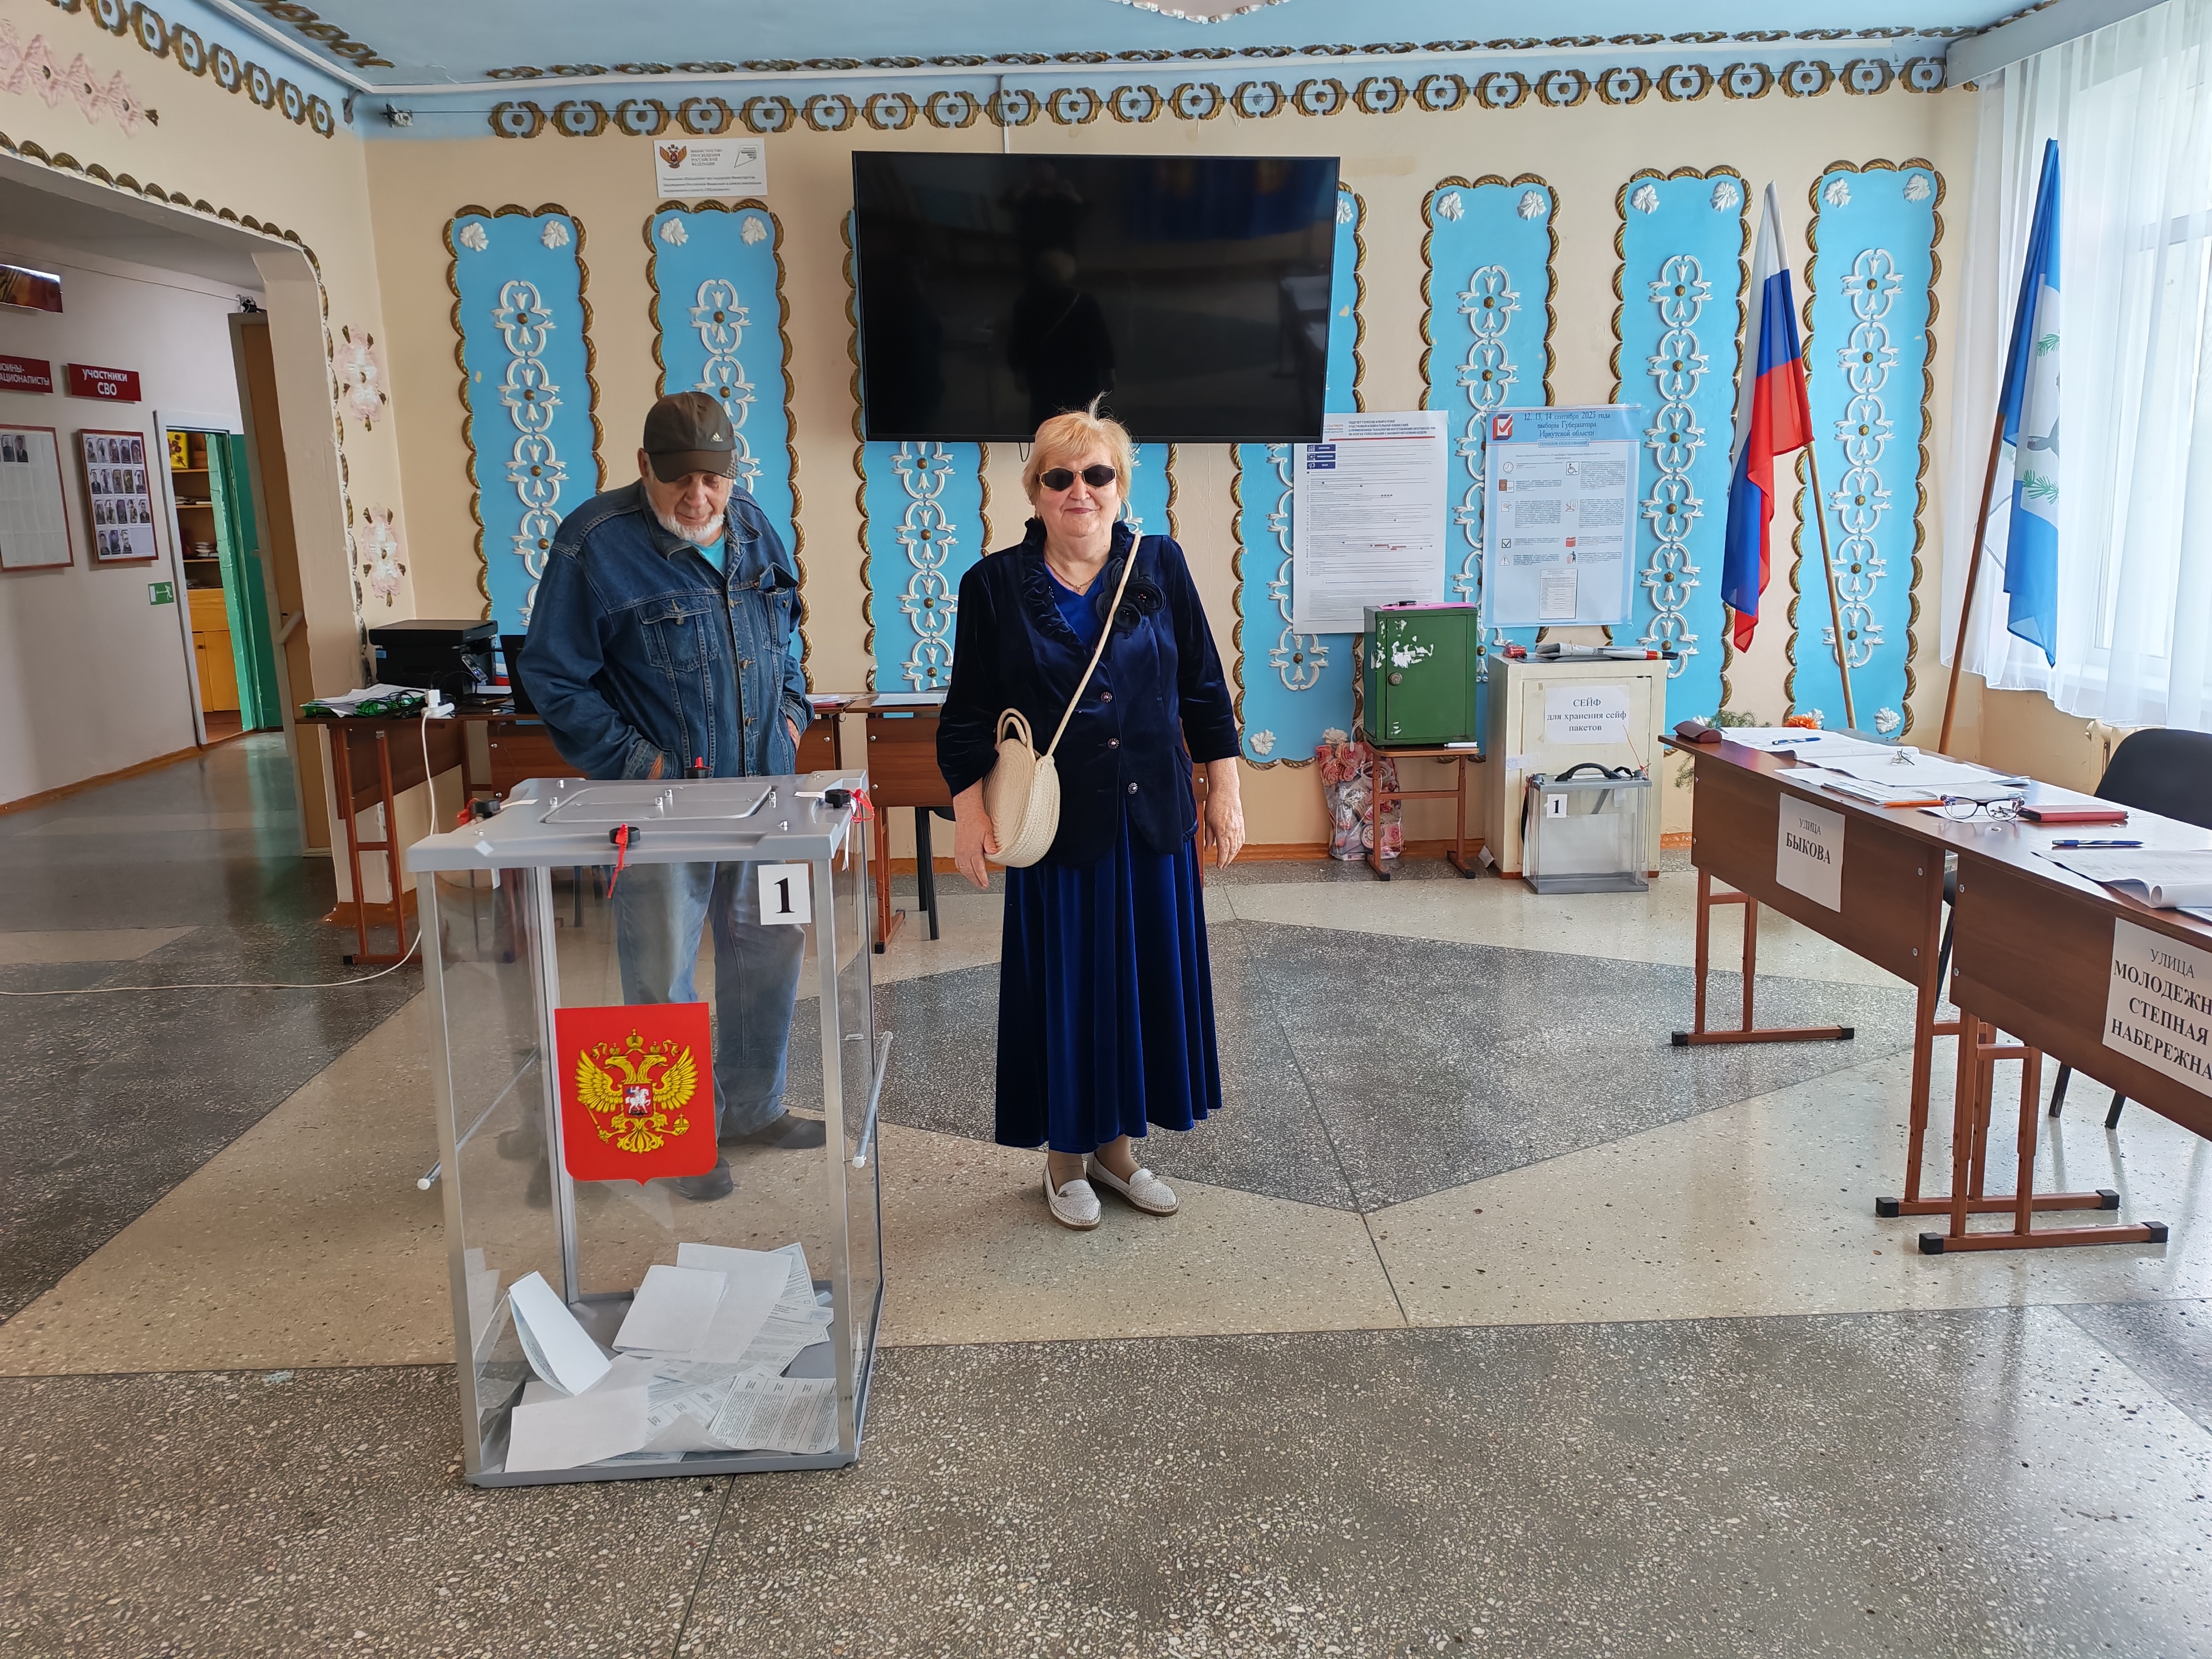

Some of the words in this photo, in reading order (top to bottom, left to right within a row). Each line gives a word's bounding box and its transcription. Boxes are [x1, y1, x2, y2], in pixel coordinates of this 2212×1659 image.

[97, 382, 117, 396] СВО
[1524, 413, 1532, 421] 12,
[1537, 422, 1559, 430] выборы
[1561, 420, 1597, 429] Губернатора
[1539, 429, 1570, 439] Иркутской
[1573, 697, 1601, 707] СЕЙФ
[1547, 713, 1562, 721] для
[1564, 713, 1603, 722] хранения
[1606, 710, 1627, 721] сейф
[1552, 799, 1561, 814] 1
[1799, 818, 1822, 836] УЛИЦА
[1785, 832, 1831, 865] БЫКОВА
[773, 877, 795, 914] 1
[2150, 948, 2195, 979] УЛИЦА
[2113, 959, 2212, 1016] МОЛОДЕЖН
[2129, 996, 2209, 1046] СТЕПНАЯ
